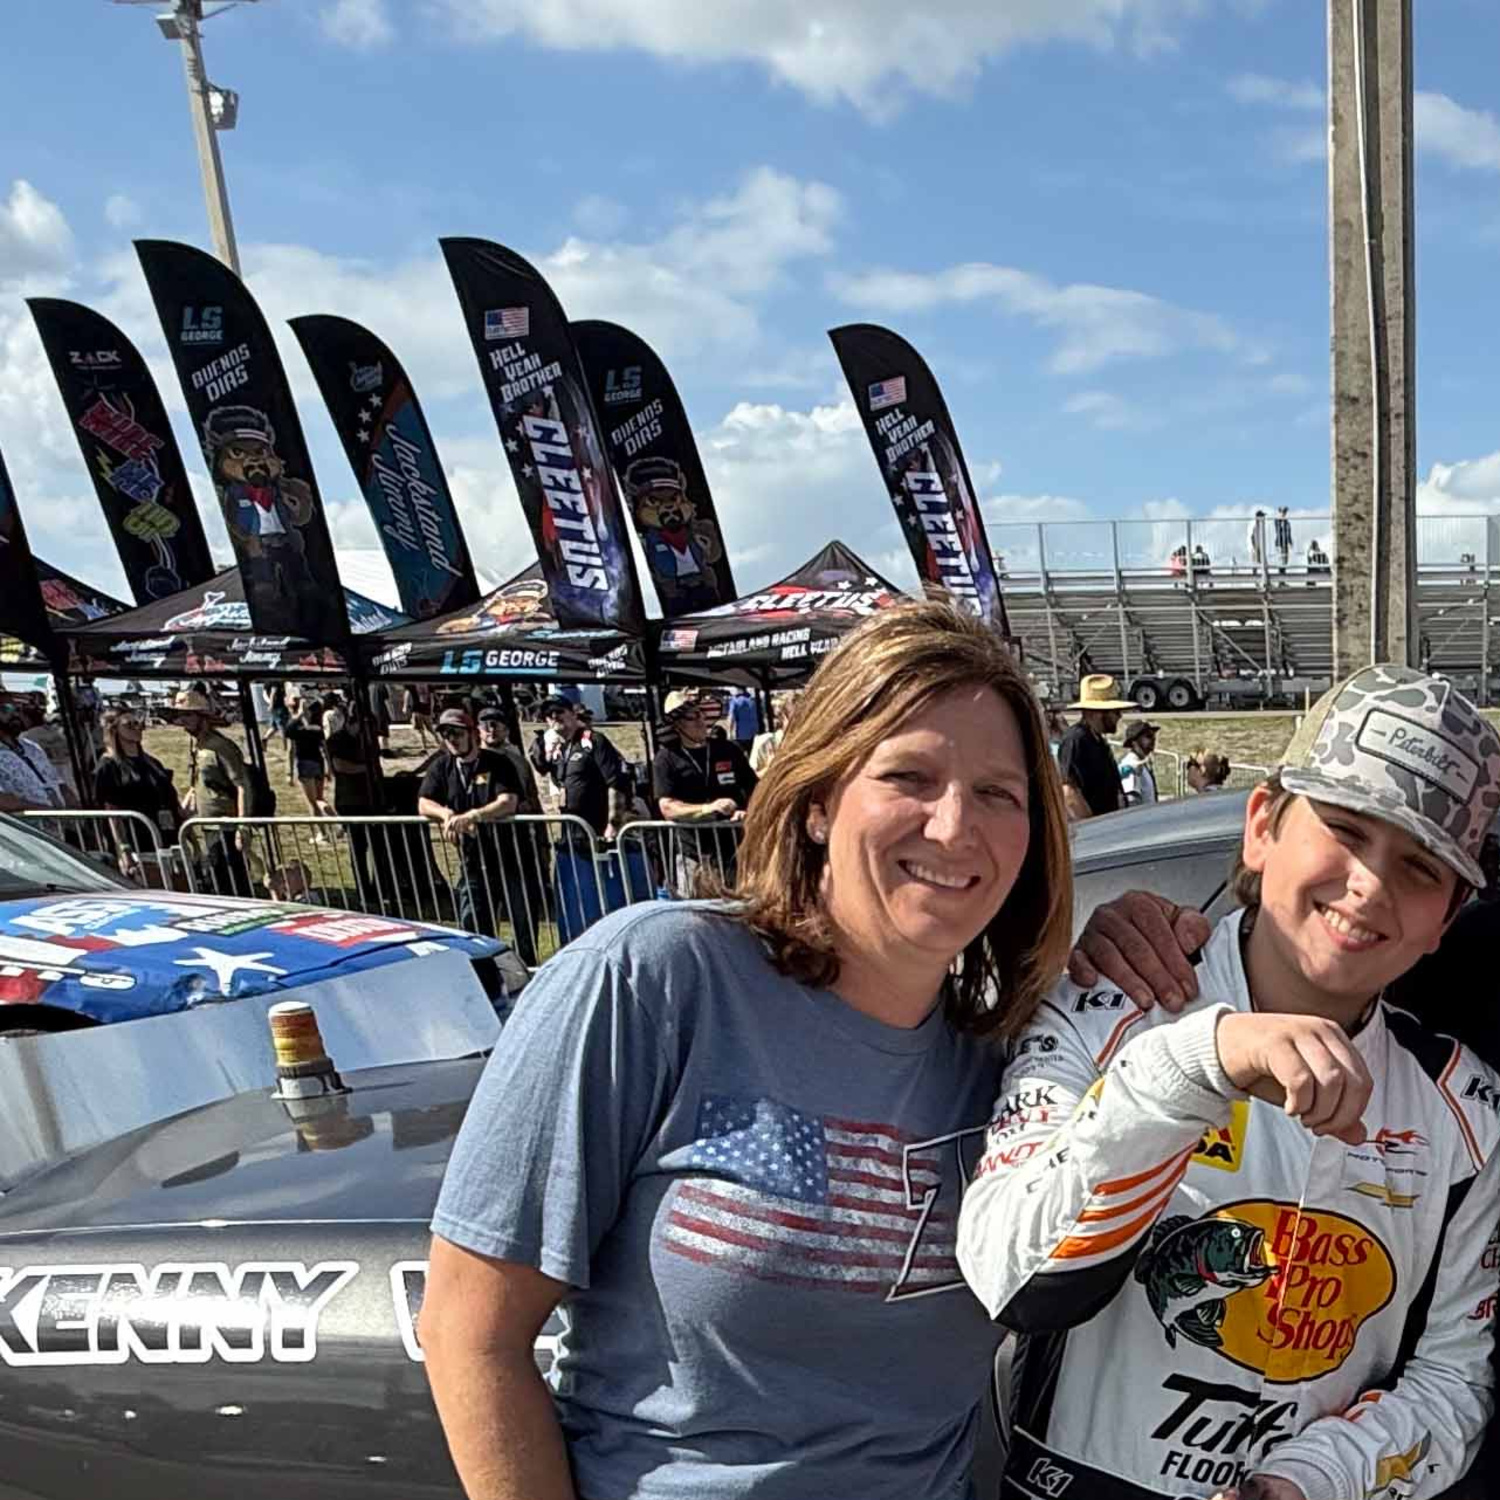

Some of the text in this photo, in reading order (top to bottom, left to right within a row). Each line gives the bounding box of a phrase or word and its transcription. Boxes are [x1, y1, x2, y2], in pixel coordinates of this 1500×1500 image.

[181, 330, 223, 341] GEORGE
[183, 306, 222, 329] LS
[191, 342, 250, 389] BUENOS
[490, 342, 525, 370] HELL
[504, 353, 542, 382] YEAH
[206, 364, 248, 402] DIAS
[500, 361, 562, 402] BROTHER
[611, 398, 663, 446] BUENOS
[624, 418, 662, 456] DIAS
[875, 408, 904, 436] HELL
[885, 419, 935, 462] BROTHER
[889, 415, 917, 444] YEAH
[372, 453, 418, 551] Jimmy
[386, 424, 463, 577] Jackstand
[523, 415, 609, 591] CLEETUS
[905, 471, 983, 617] CLEETU
[440, 651, 560, 674] LS GEORGE
[781, 643, 808, 660] HELL
[1271, 1209, 1375, 1267] Bass
[1264, 1258, 1343, 1309] Pro
[0, 1261, 360, 1366] KENNY
